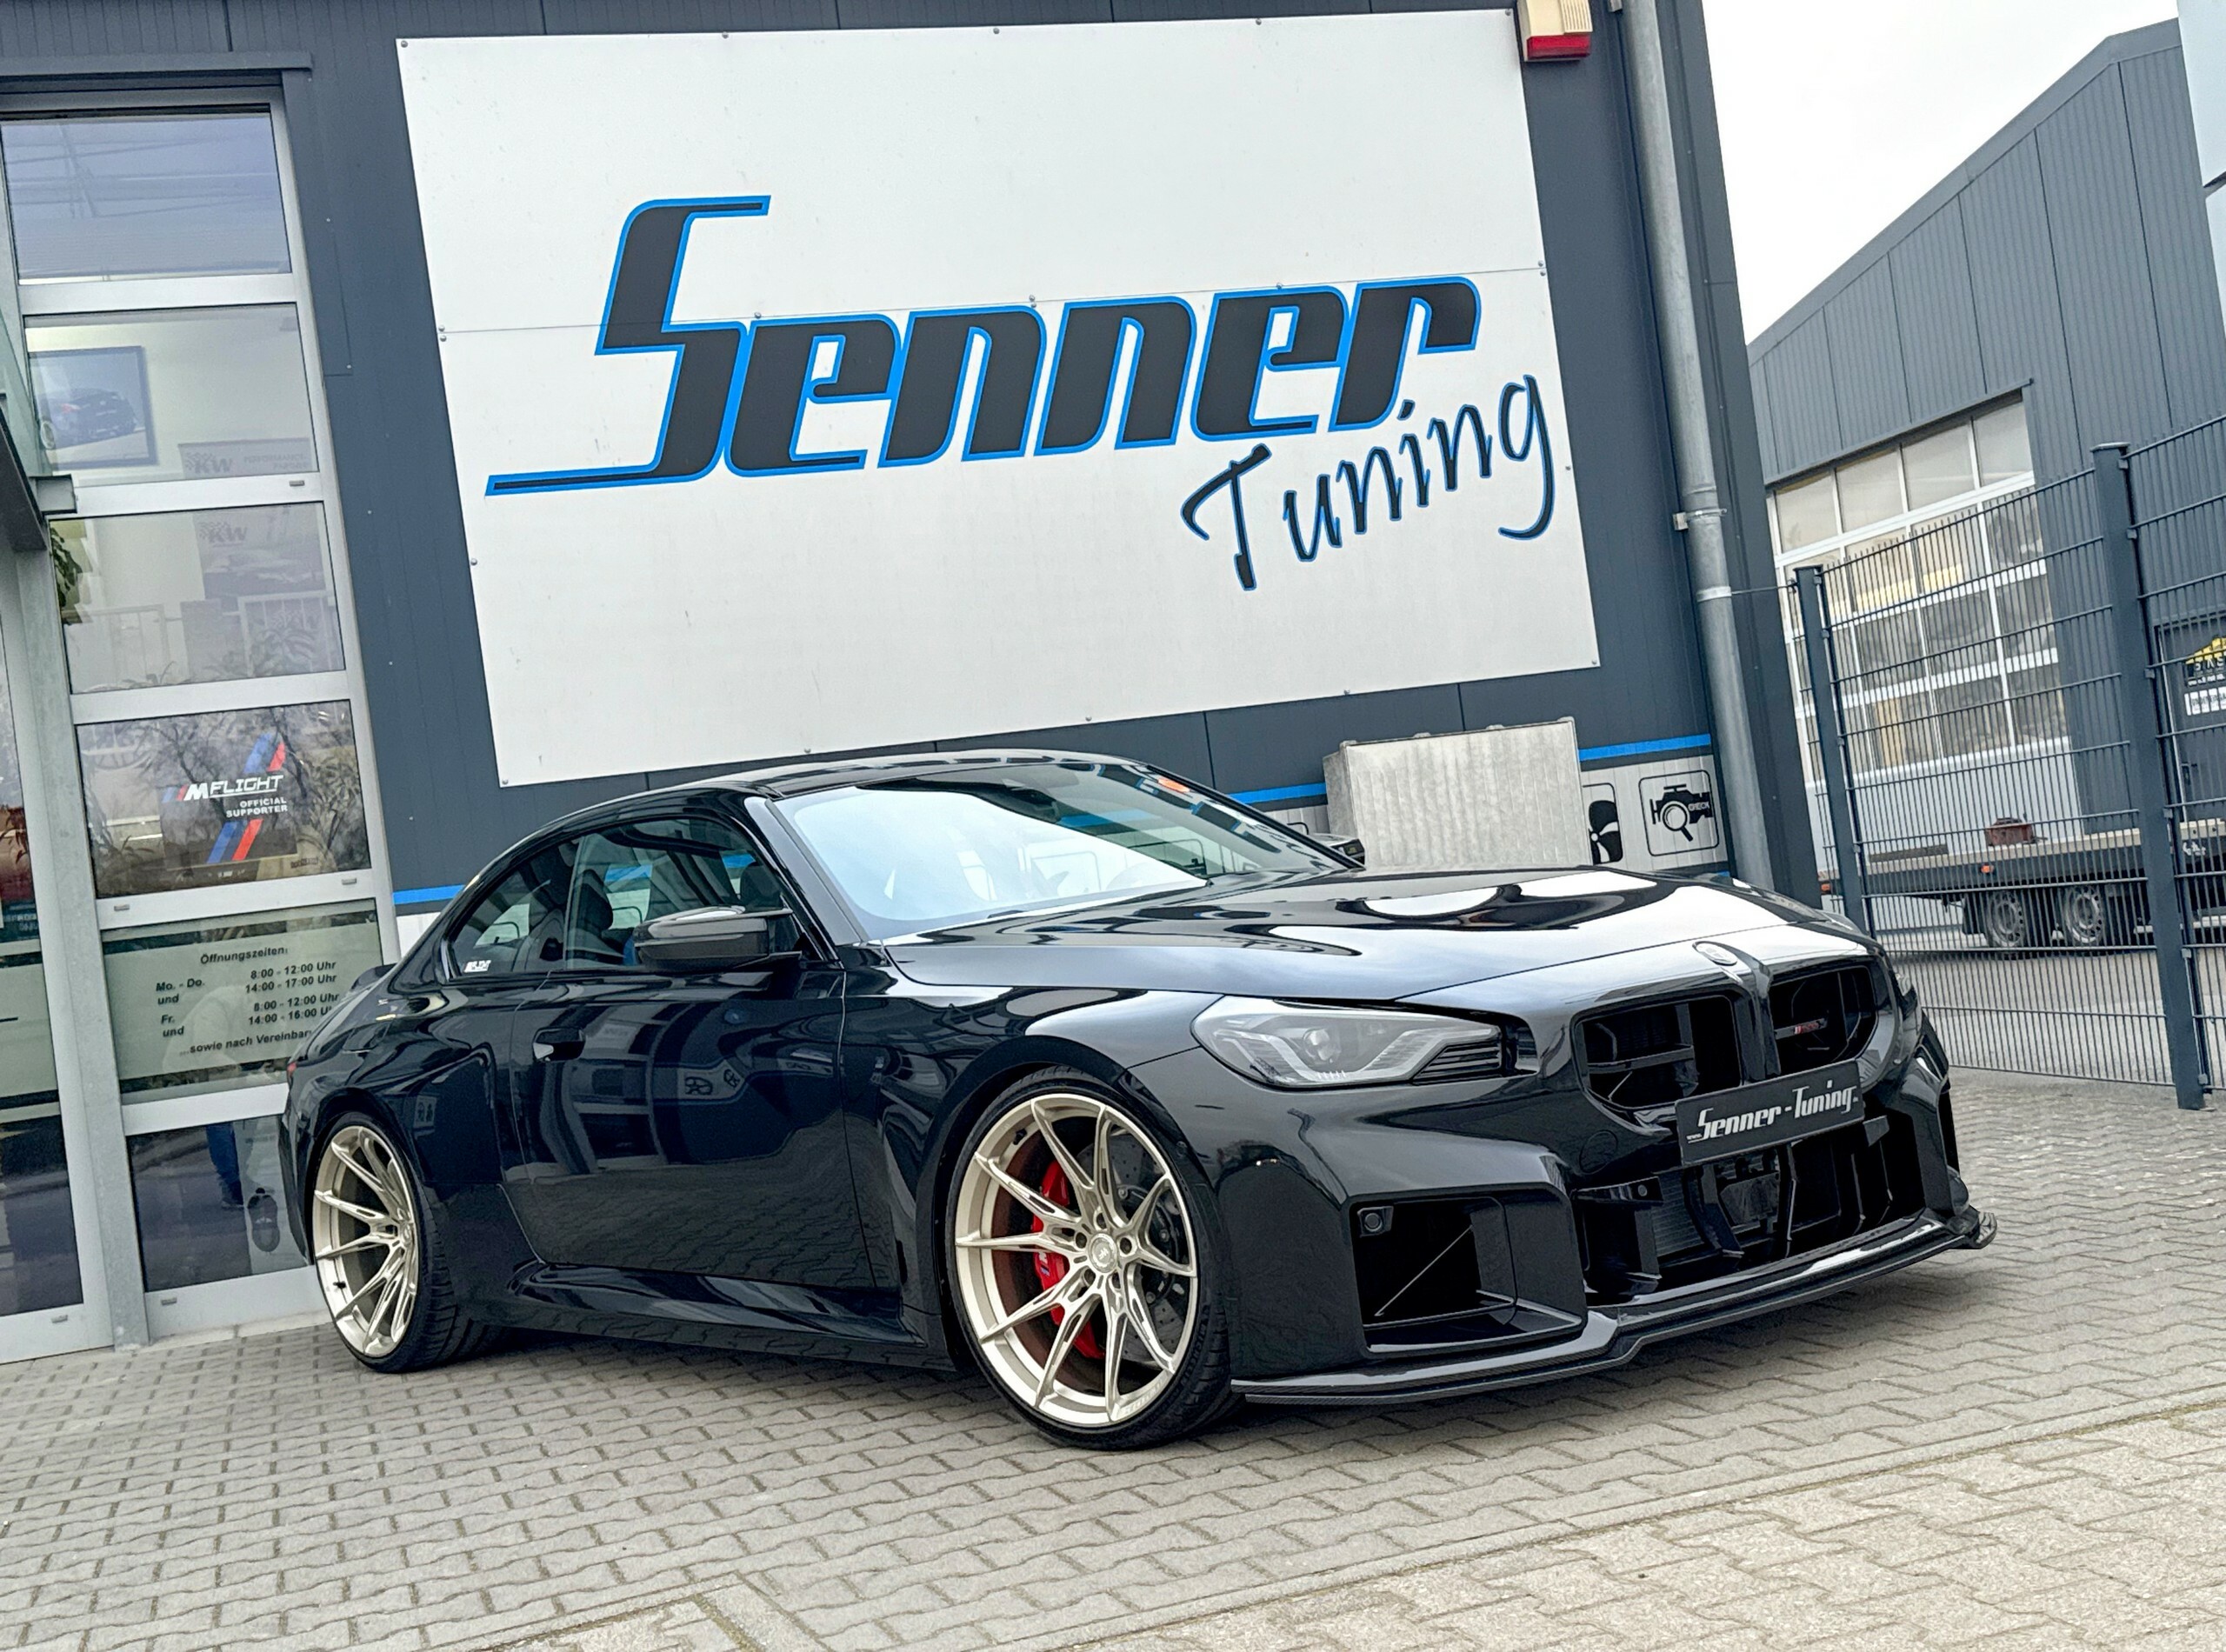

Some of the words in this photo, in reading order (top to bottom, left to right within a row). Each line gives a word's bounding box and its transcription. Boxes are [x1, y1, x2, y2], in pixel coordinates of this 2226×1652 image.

[484, 195, 1482, 496] Senner
[1181, 373, 1558, 591] Tuning
[226, 804, 288, 818] SUPPORTER
[239, 797, 287, 808] OFFICIAL
[200, 947, 289, 964] Öffnungszeiten:
[156, 983, 176, 991] Mo.
[186, 978, 205, 989] Do.
[250, 969, 274, 980] 8:00
[284, 963, 314, 976] 12:00
[317, 961, 337, 971] Uhr
[157, 995, 179, 1005] und
[246, 982, 275, 993] 14:00
[285, 976, 314, 988] 17:00
[317, 975, 337, 985] Uhr
[160, 1014, 175, 1024] Fr.
[254, 1000, 277, 1011] 8:00
[287, 996, 317, 1007] 12:00
[319, 992, 340, 1003] Uhr
[163, 1026, 184, 1037] und
[249, 1014, 277, 1026] 14:00
[288, 1009, 317, 1021] 16:00
[225, 1036, 253, 1049] nach
[257, 1030, 311, 1045] Vereinbar
